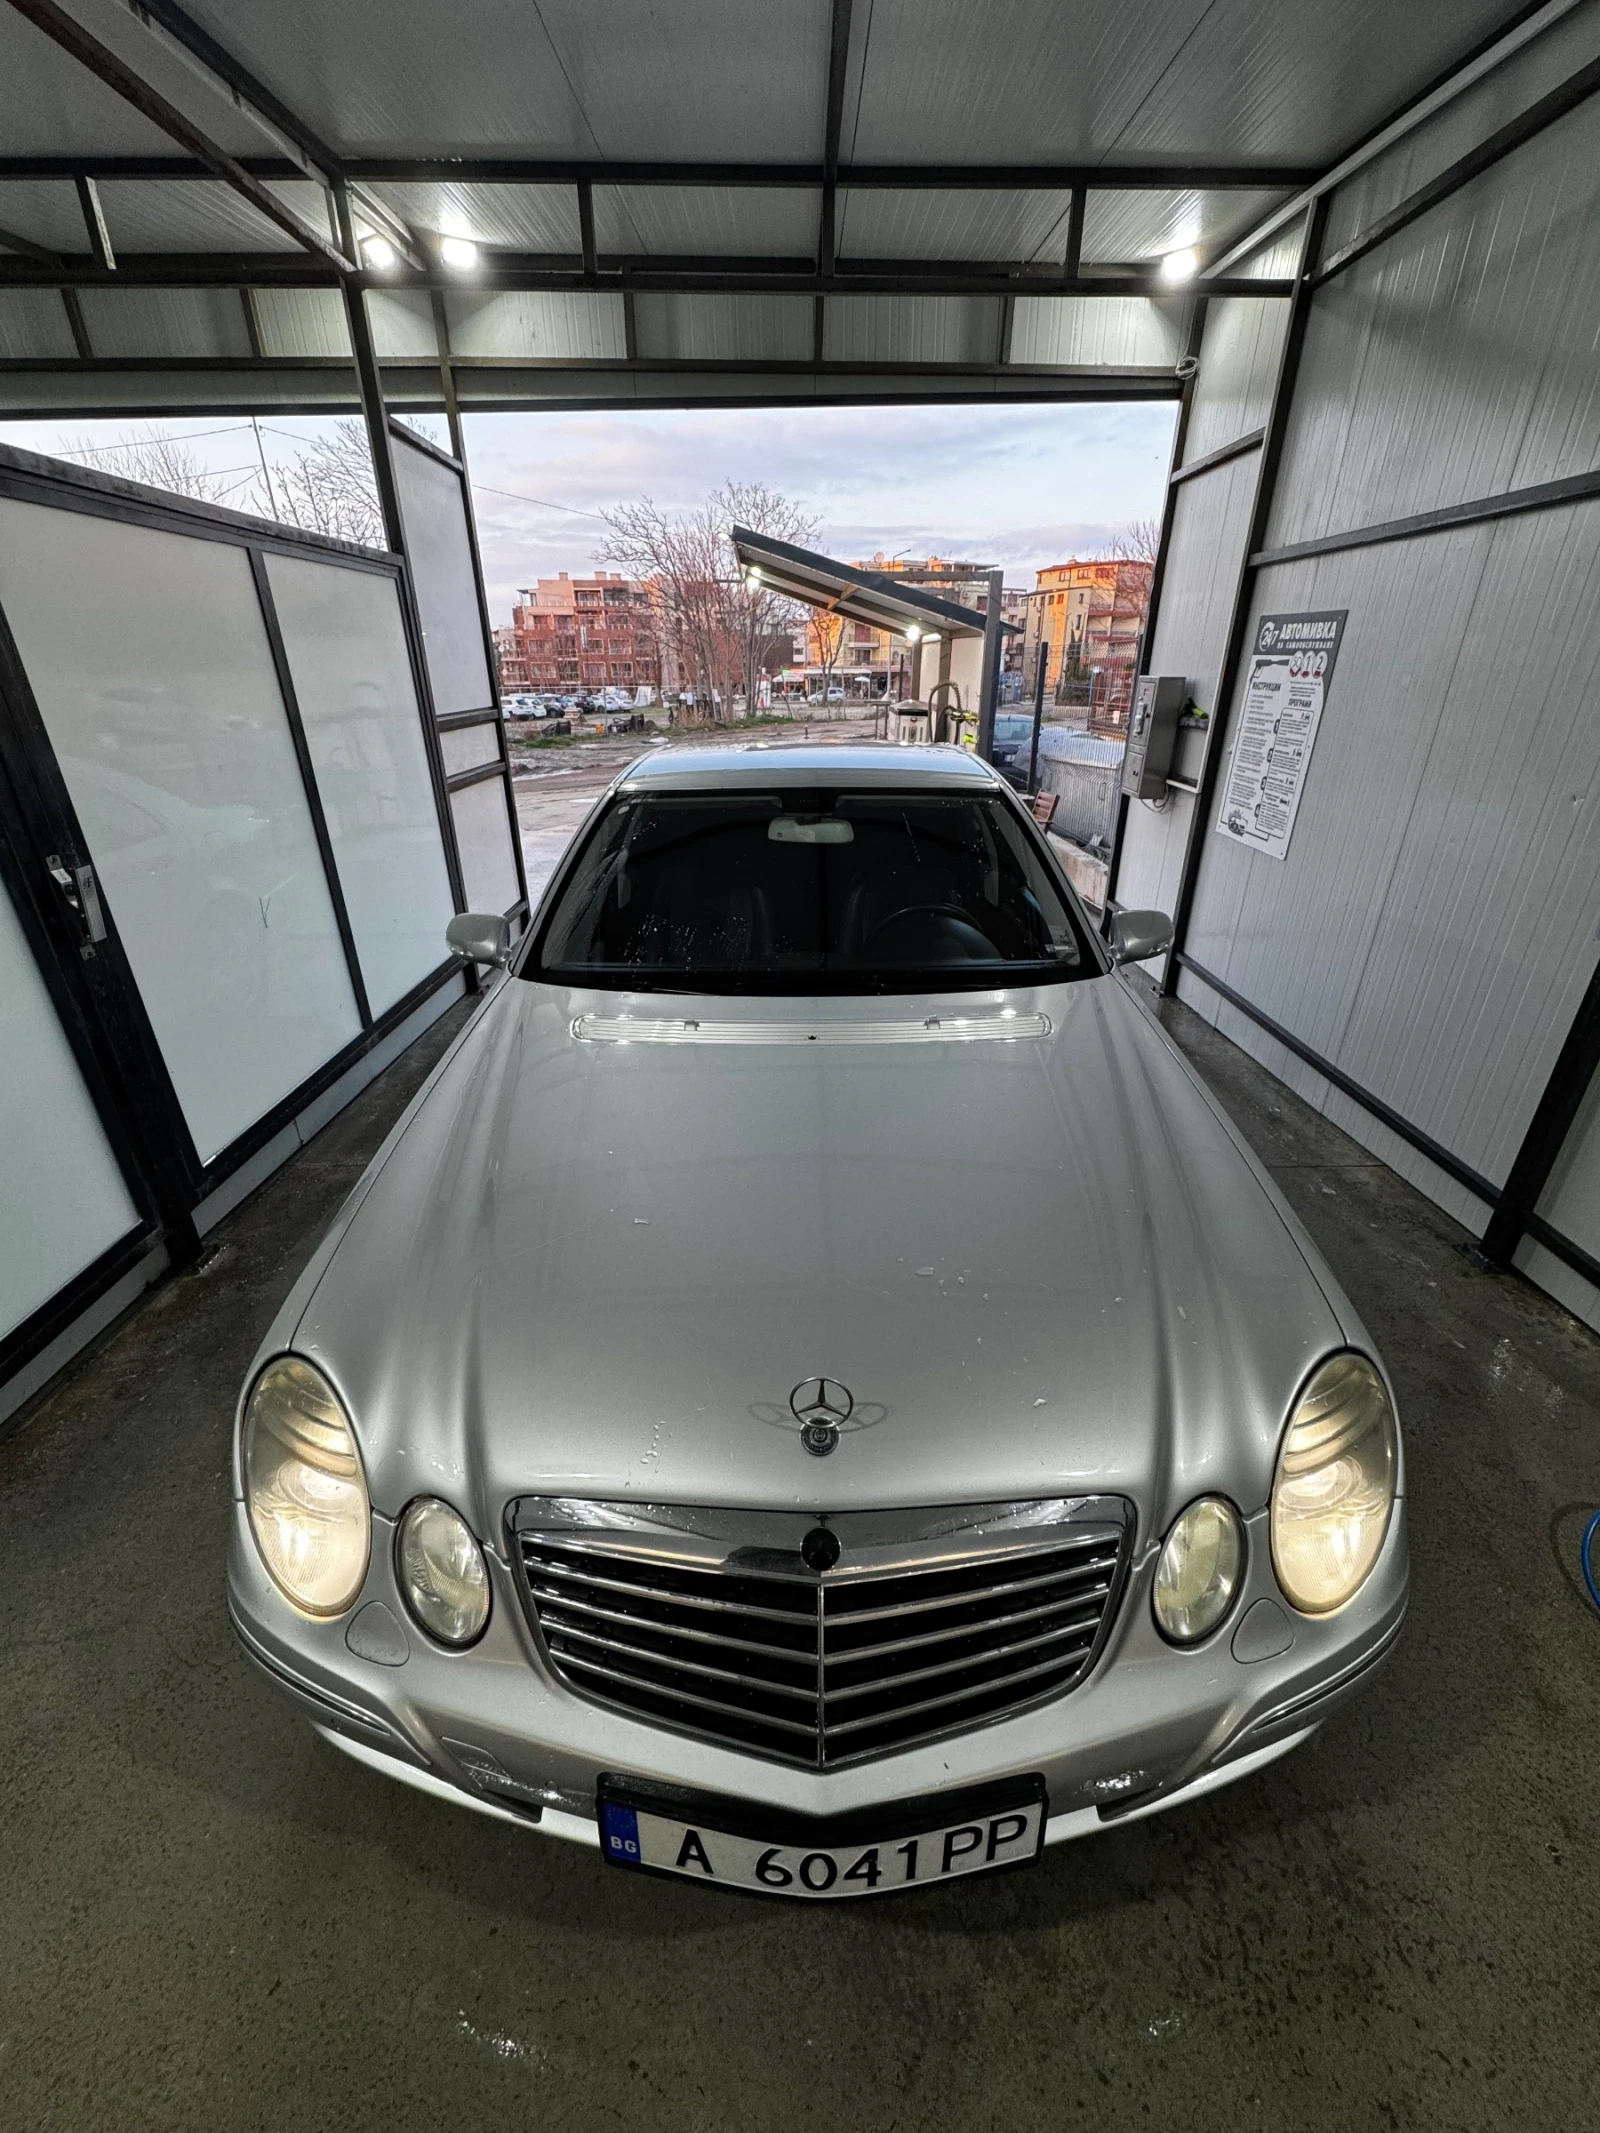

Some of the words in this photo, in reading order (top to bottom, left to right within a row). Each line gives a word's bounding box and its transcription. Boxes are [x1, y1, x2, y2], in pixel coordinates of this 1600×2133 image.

[1279, 621, 1337, 640] АВТОМИВКА
[1276, 641, 1284, 649] НА
[610, 1835, 637, 1854] BG
[676, 1828, 714, 1875] A
